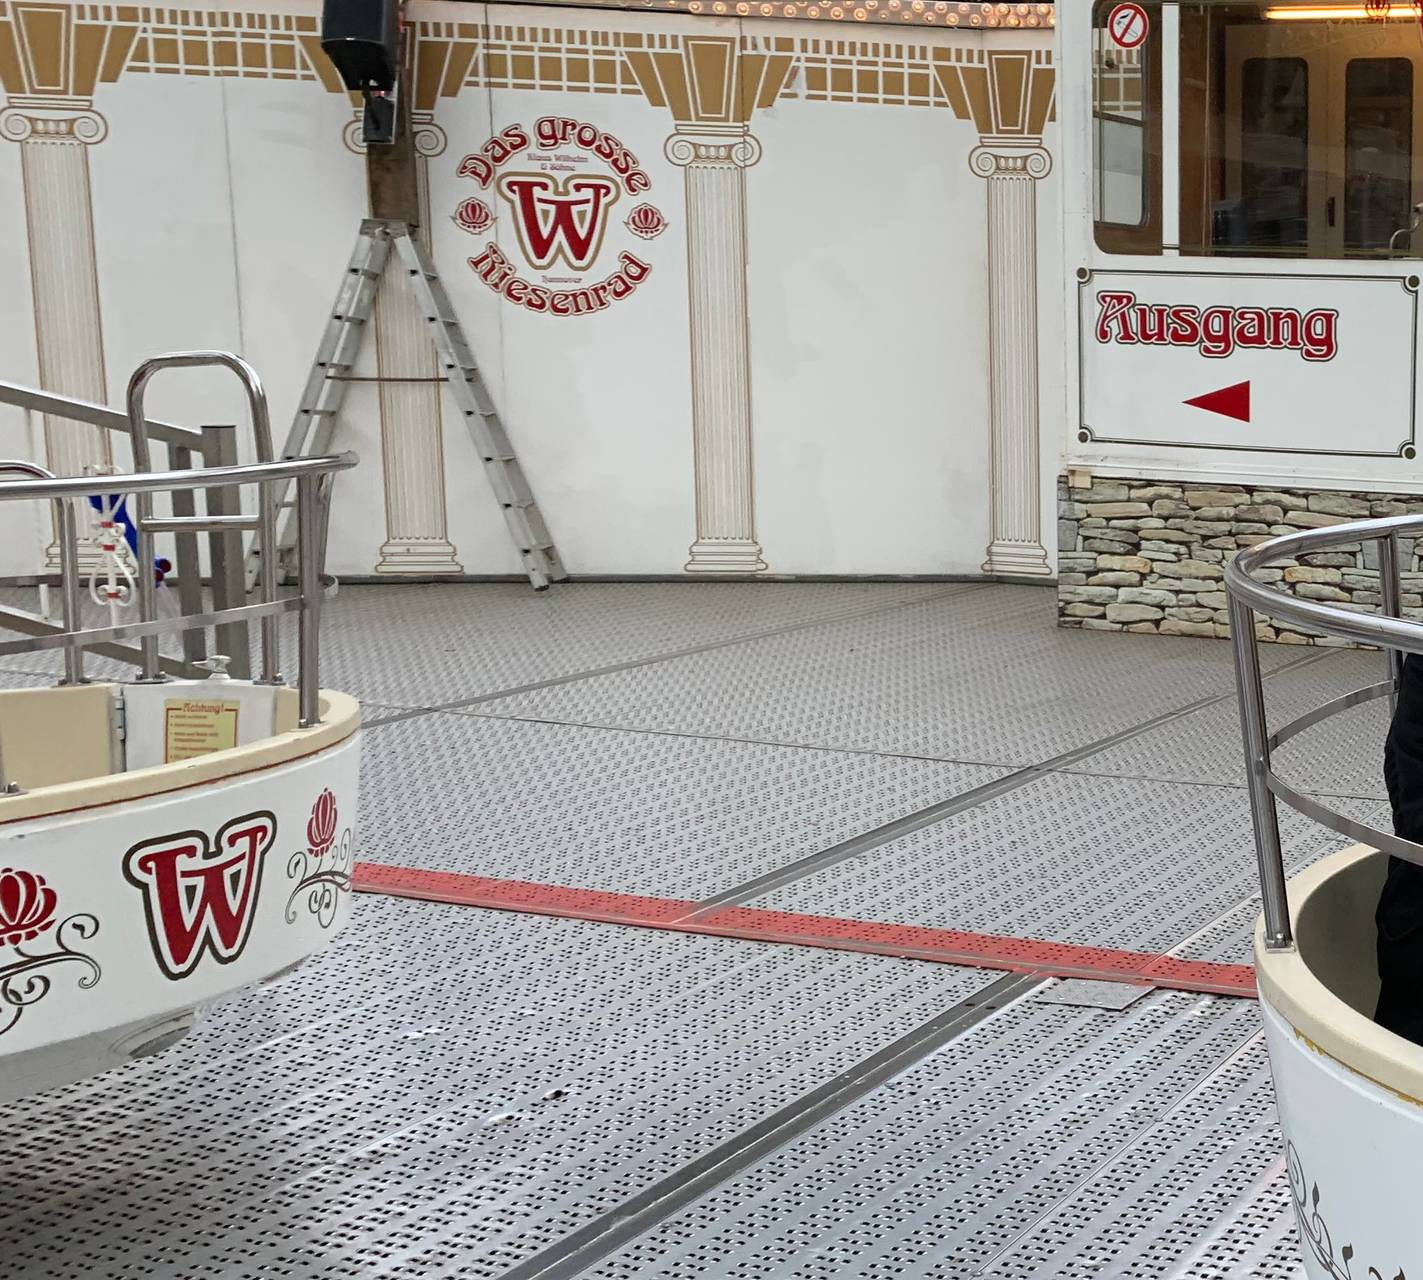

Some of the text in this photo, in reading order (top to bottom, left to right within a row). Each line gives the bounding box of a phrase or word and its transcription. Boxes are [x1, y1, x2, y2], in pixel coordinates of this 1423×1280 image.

[457, 116, 652, 195] Das grosse
[501, 176, 617, 267] W
[467, 242, 652, 316] Riesenrad
[1096, 290, 1339, 362] Ausgang
[128, 816, 274, 976] W
